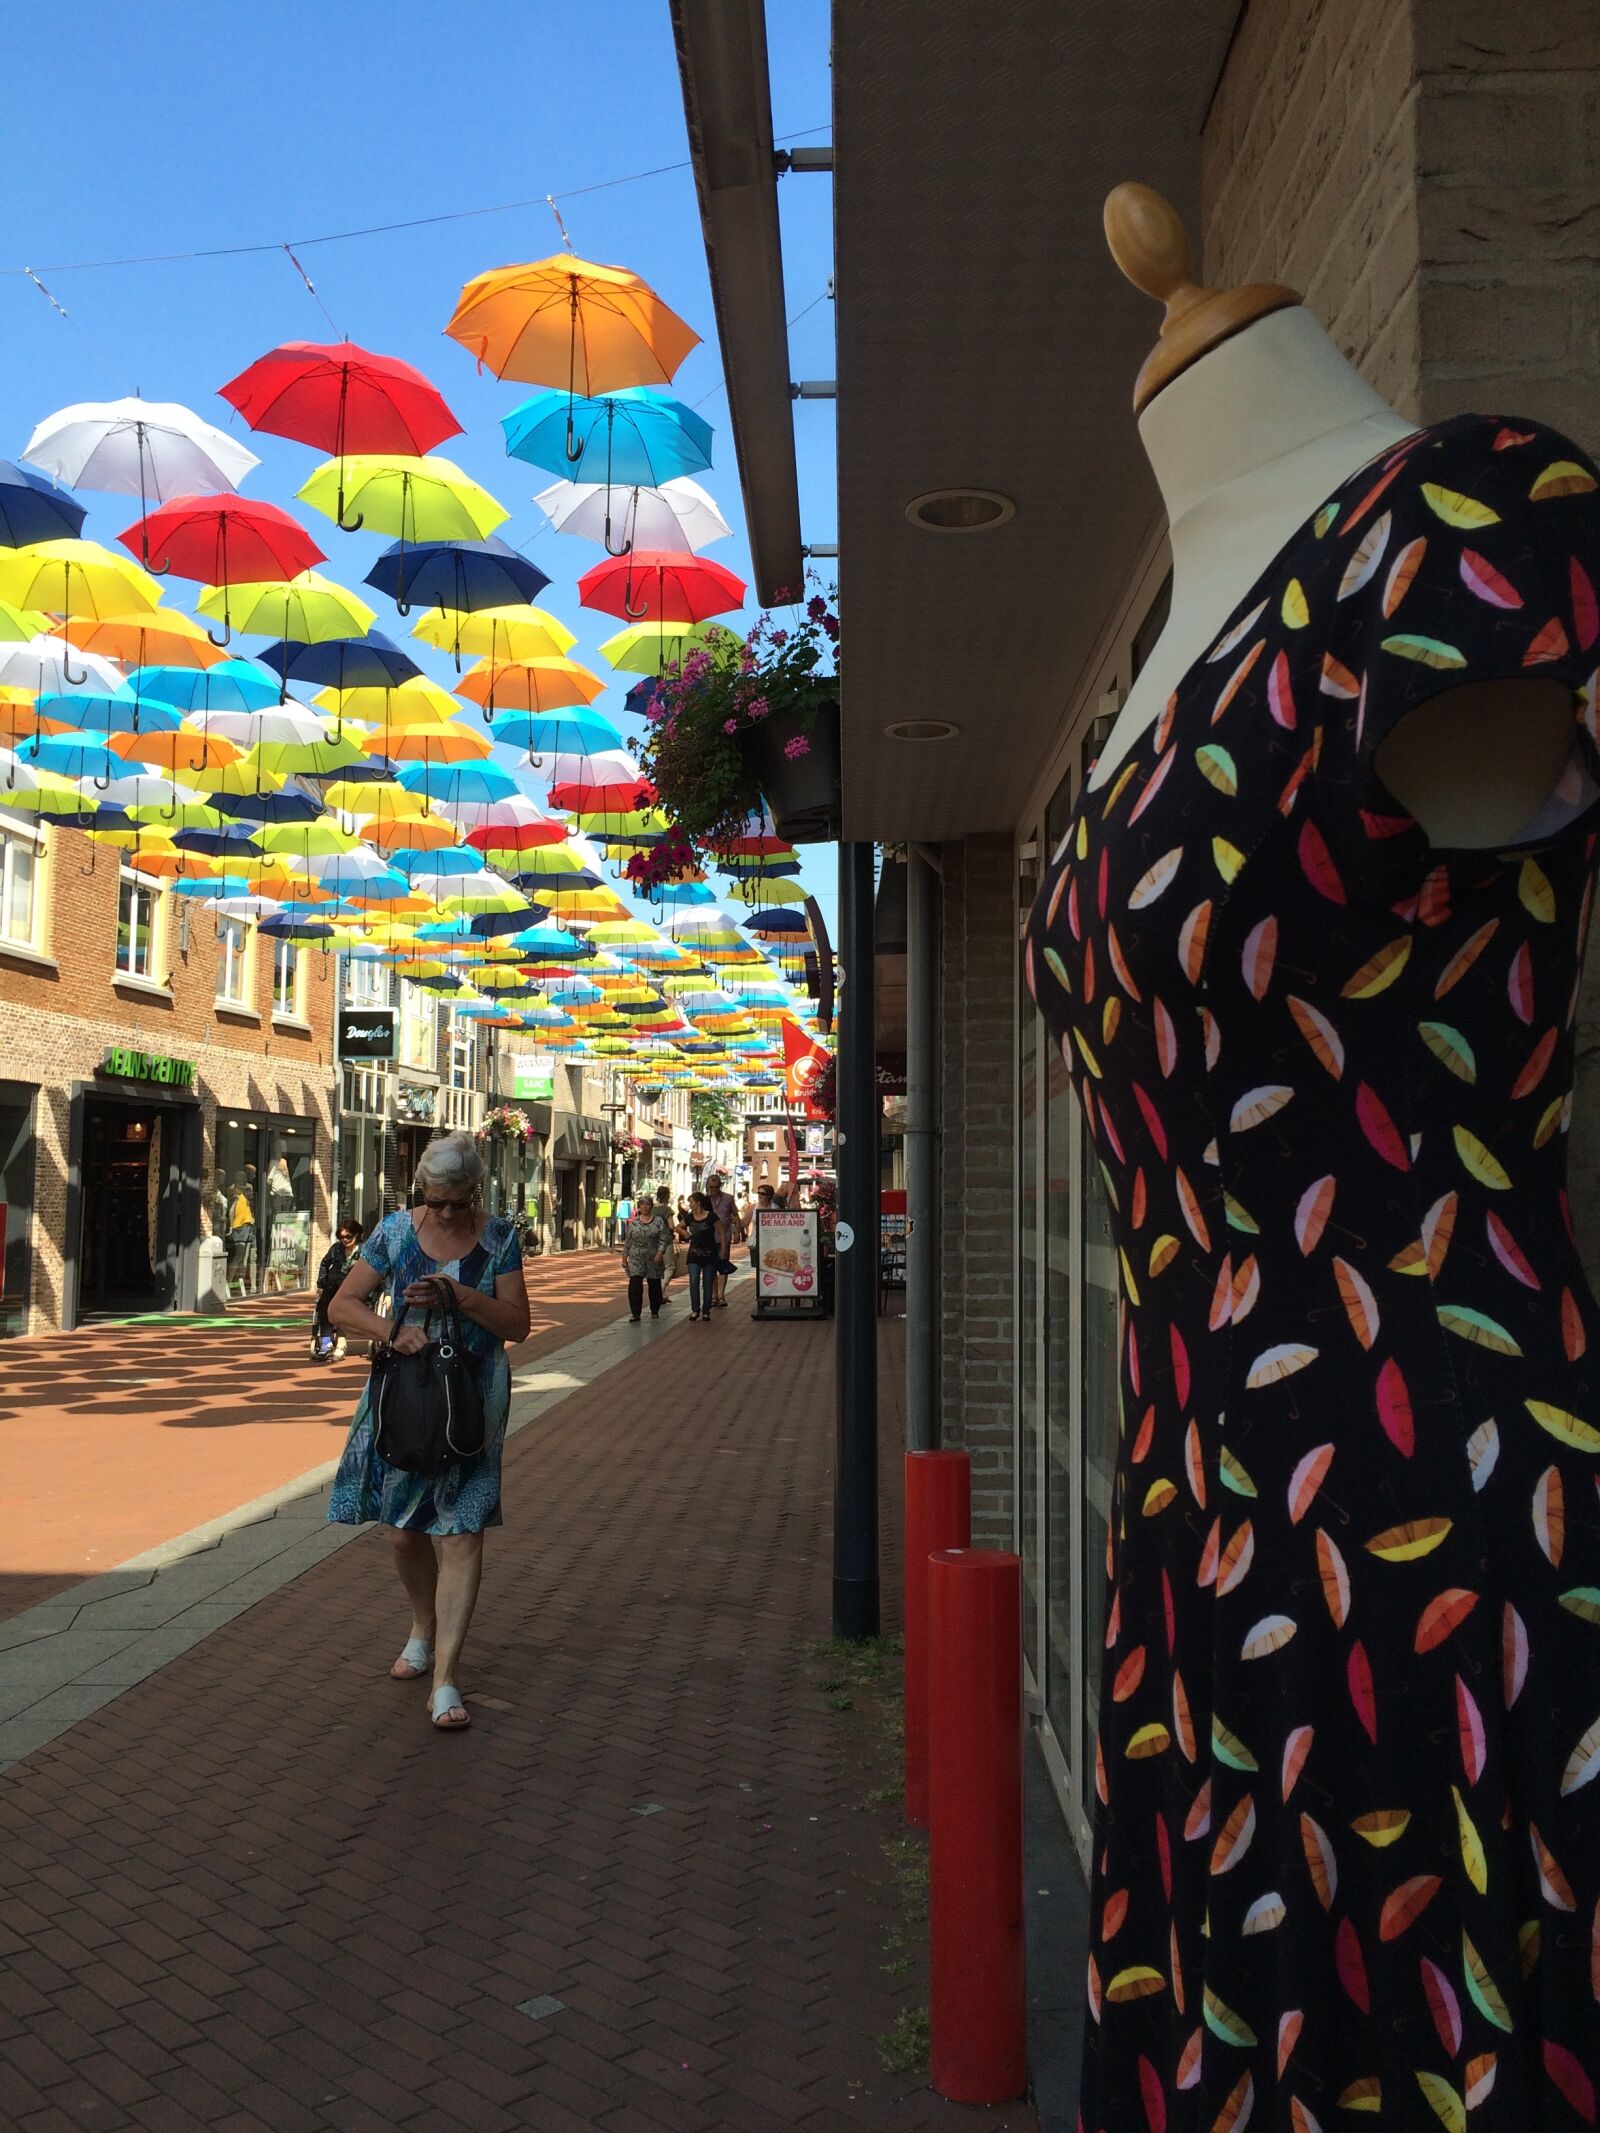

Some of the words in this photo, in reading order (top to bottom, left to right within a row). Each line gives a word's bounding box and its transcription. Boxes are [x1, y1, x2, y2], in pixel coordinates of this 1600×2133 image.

[346, 1025, 390, 1041] Douglas
[105, 1047, 148, 1079] JEANS
[151, 1054, 197, 1089] CENTRE
[271, 1223, 297, 1249] NEW
